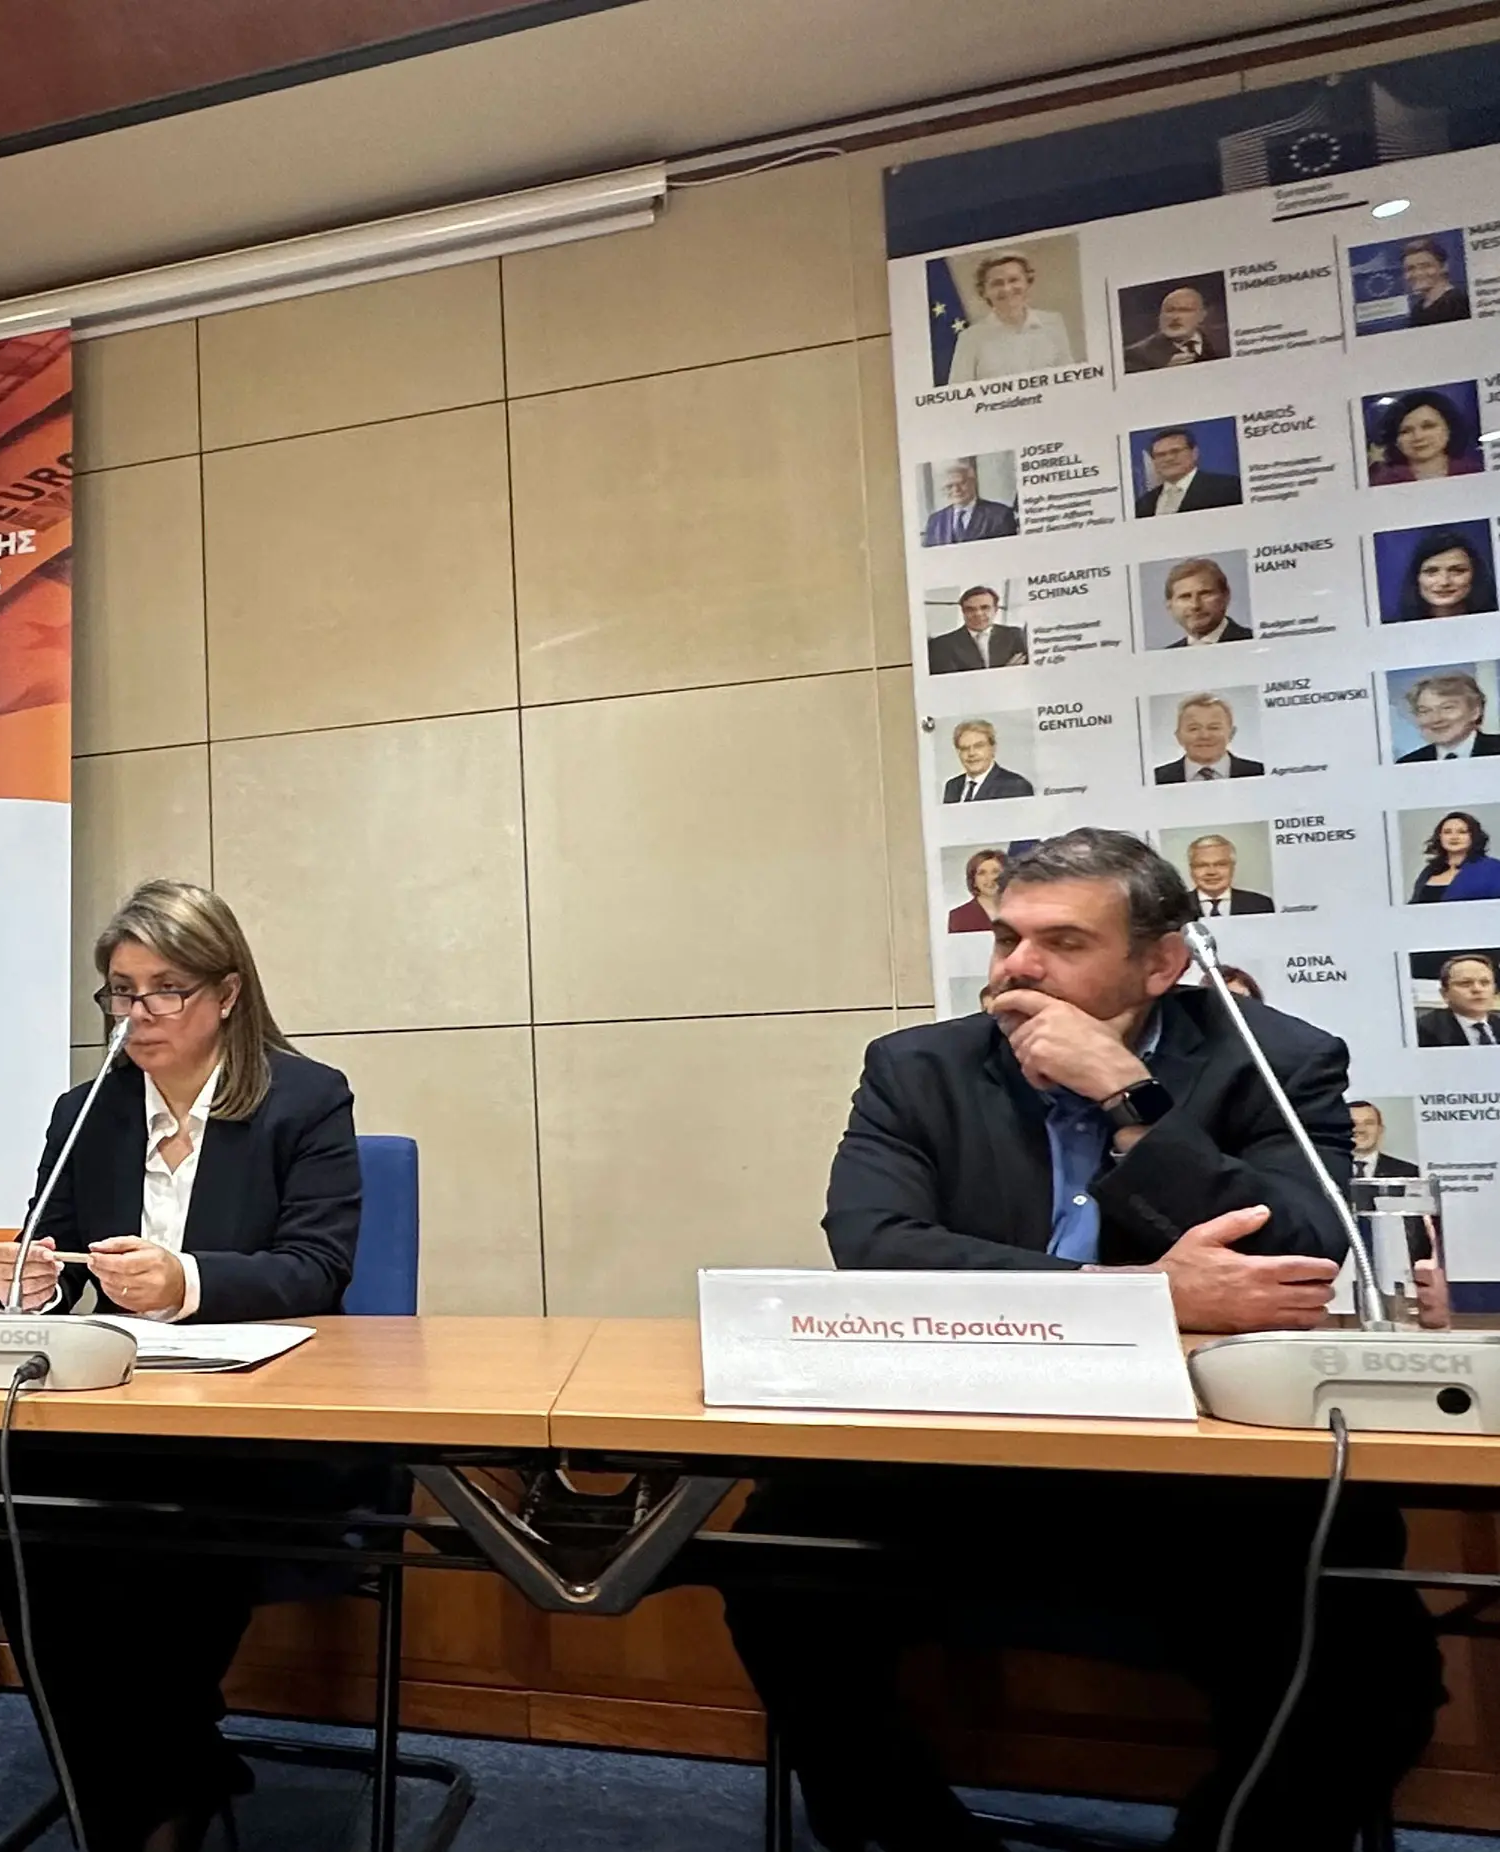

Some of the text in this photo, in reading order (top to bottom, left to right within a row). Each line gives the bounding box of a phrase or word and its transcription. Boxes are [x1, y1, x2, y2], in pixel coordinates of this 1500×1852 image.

[1230, 260, 1277, 278] FRANS
[1231, 265, 1332, 292] TIMMERMANS
[915, 366, 1104, 407] URSULA VON DER LEYEN
[974, 394, 1043, 414] President
[1020, 442, 1064, 458] JOSEP
[1021, 454, 1082, 472] BORRELL
[1022, 466, 1100, 486] FONTELLES
[1253, 538, 1335, 558] JOHANNES
[1255, 559, 1297, 573] HAHN
[1027, 566, 1111, 586] MARGARITIS
[1028, 583, 1089, 601] SCHINAS
[1037, 702, 1083, 716] PAOLO
[1038, 715, 1113, 731] GENTILONI
[1274, 815, 1325, 830] DIDIER
[1275, 829, 1356, 845] REYNDERS
[1286, 955, 1334, 968] ADINA
[791, 1312, 1064, 1341] Μιχάλης Περσιάνης
[1362, 1352, 1473, 1374] BOSCH
